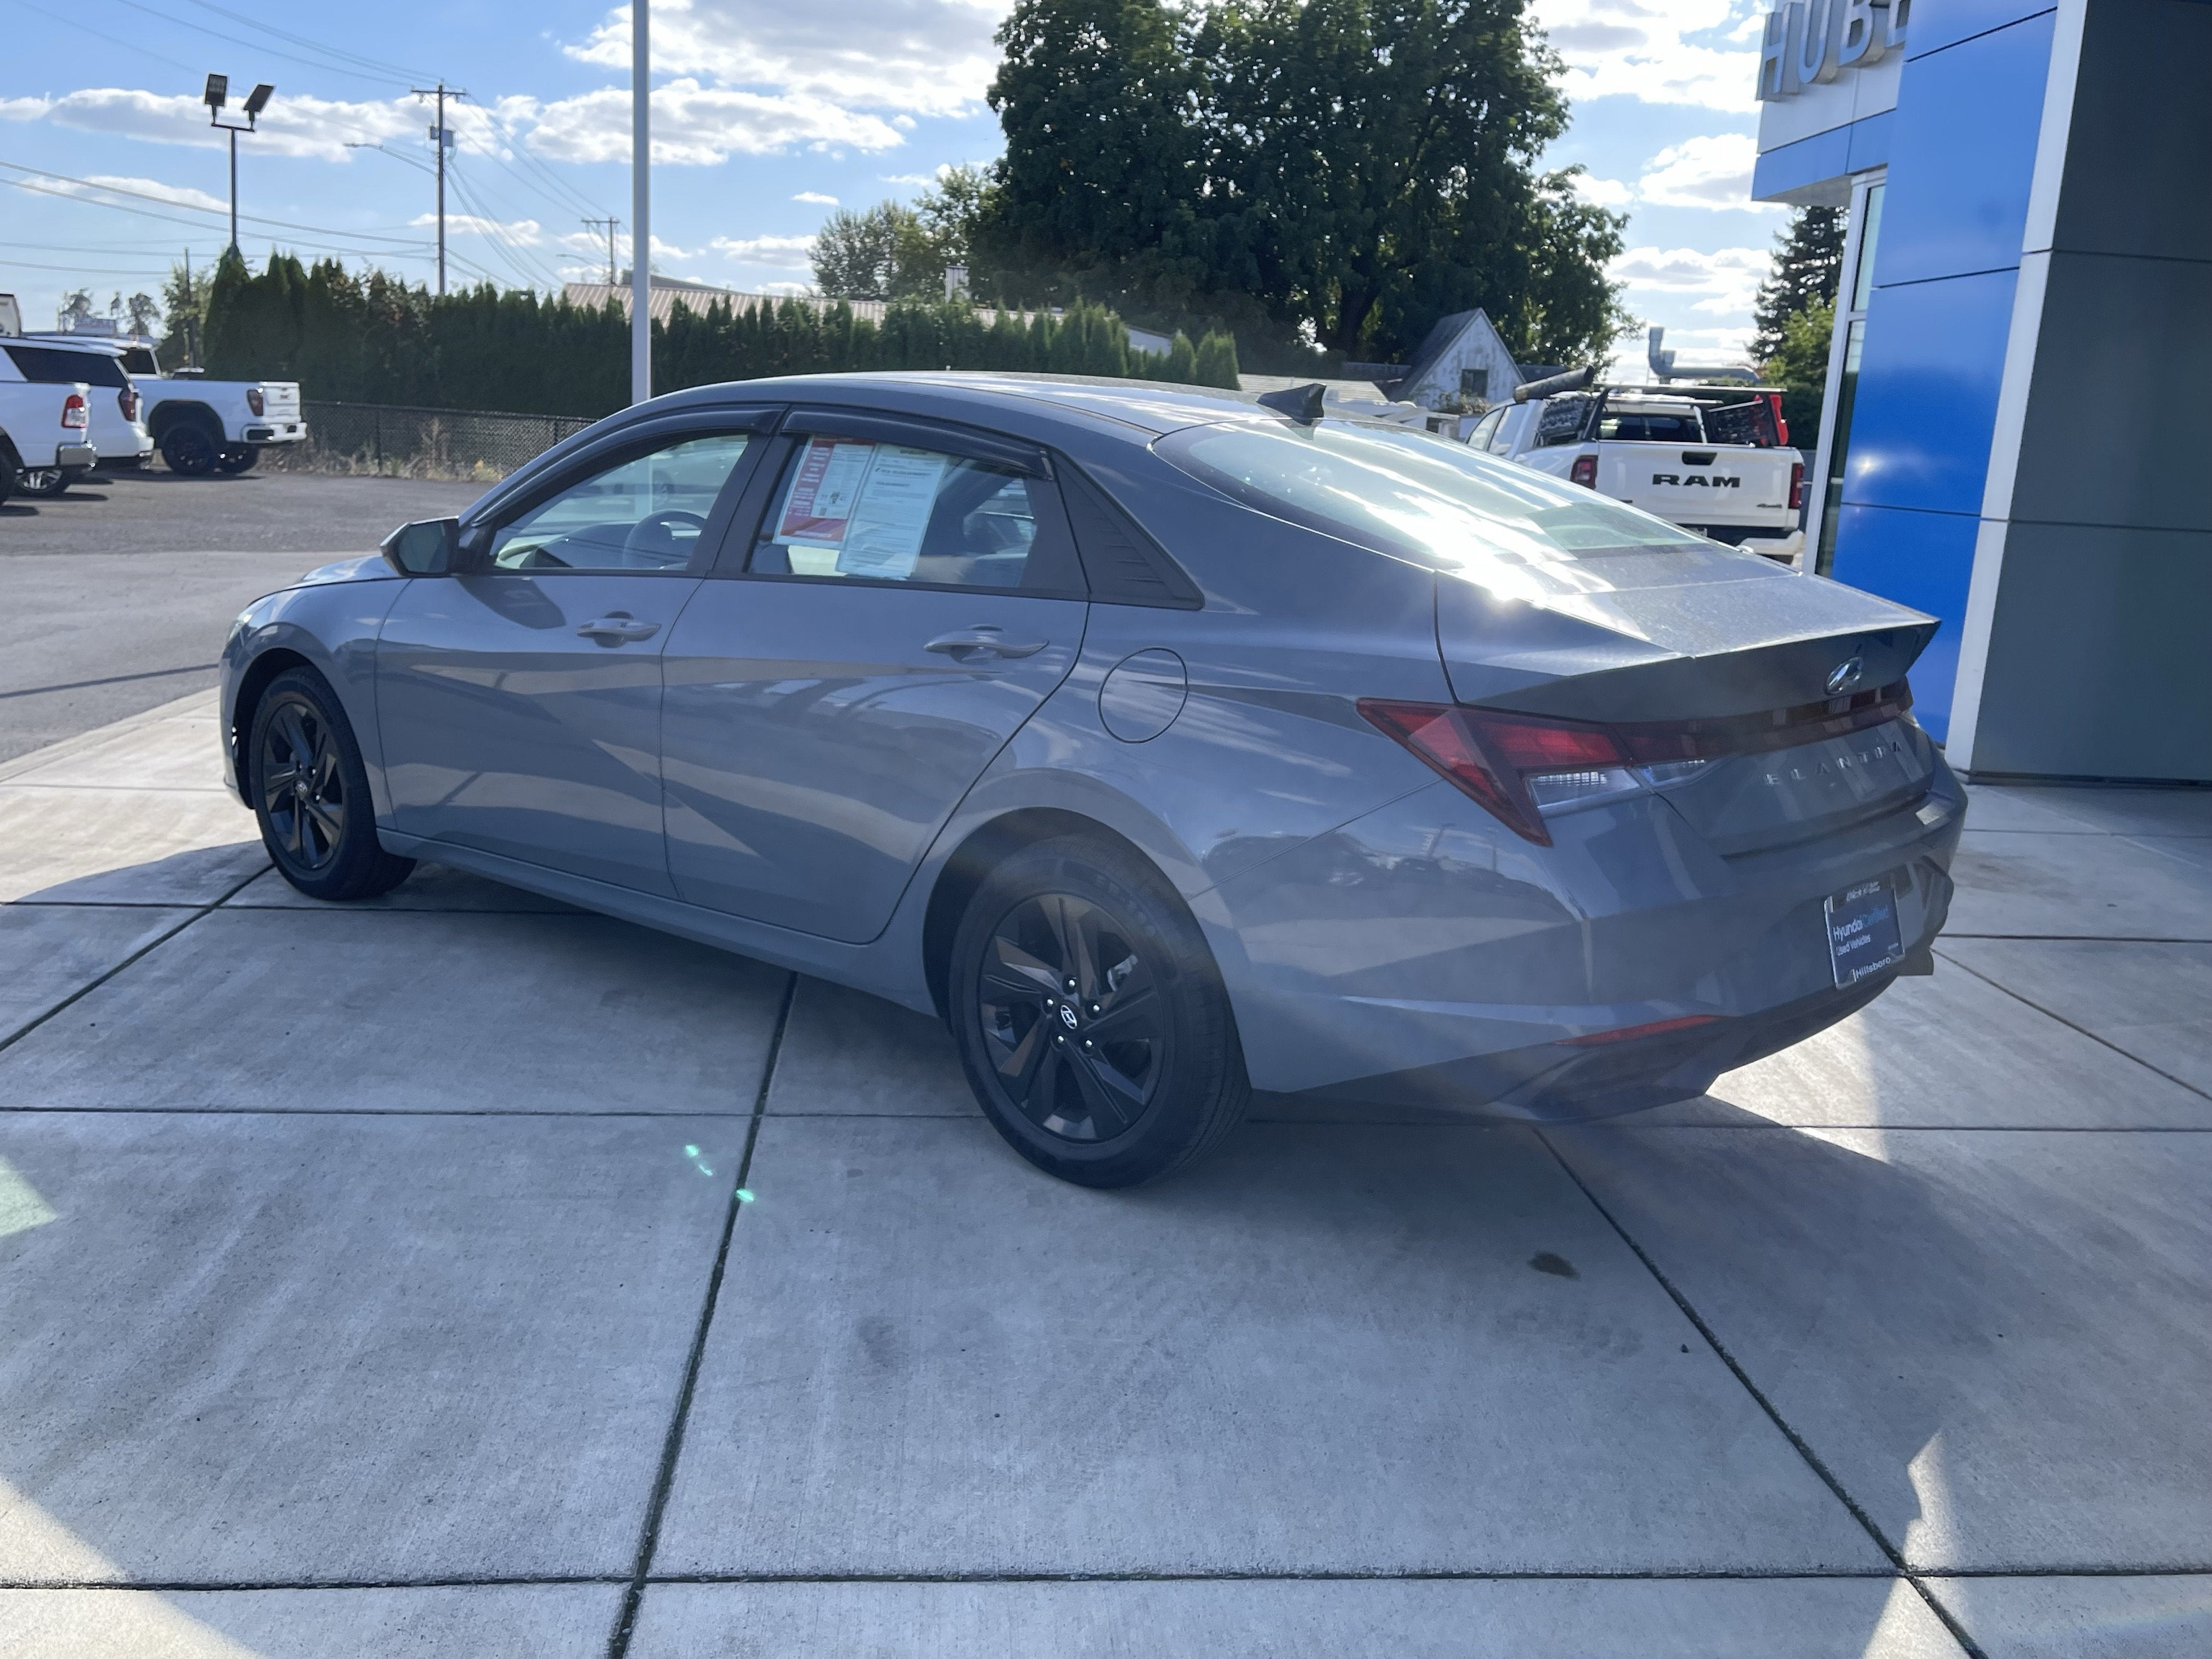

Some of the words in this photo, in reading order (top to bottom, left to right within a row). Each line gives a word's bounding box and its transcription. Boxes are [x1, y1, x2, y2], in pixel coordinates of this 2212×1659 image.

[1652, 473, 1740, 488] RAM
[1764, 741, 1903, 786] ELANTRA
[1855, 957, 1891, 979] Hillsboro
